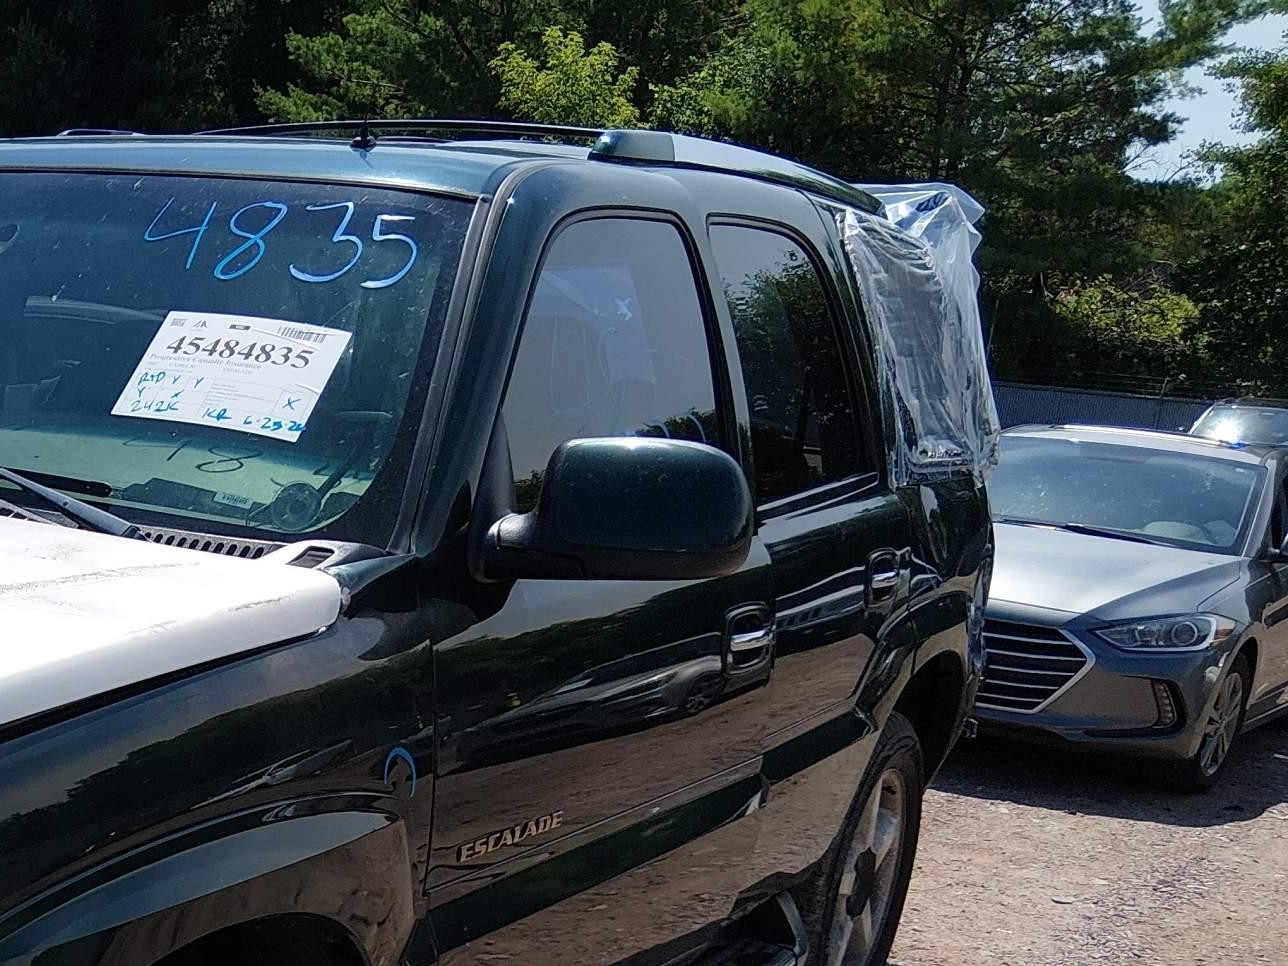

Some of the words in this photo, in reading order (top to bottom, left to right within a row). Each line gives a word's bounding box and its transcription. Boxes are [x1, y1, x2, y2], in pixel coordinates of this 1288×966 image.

[143, 196, 418, 289] 4835
[149, 353, 191, 364] Progressive
[166, 334, 316, 370] 45484835
[458, 810, 564, 863] ESCALADE
